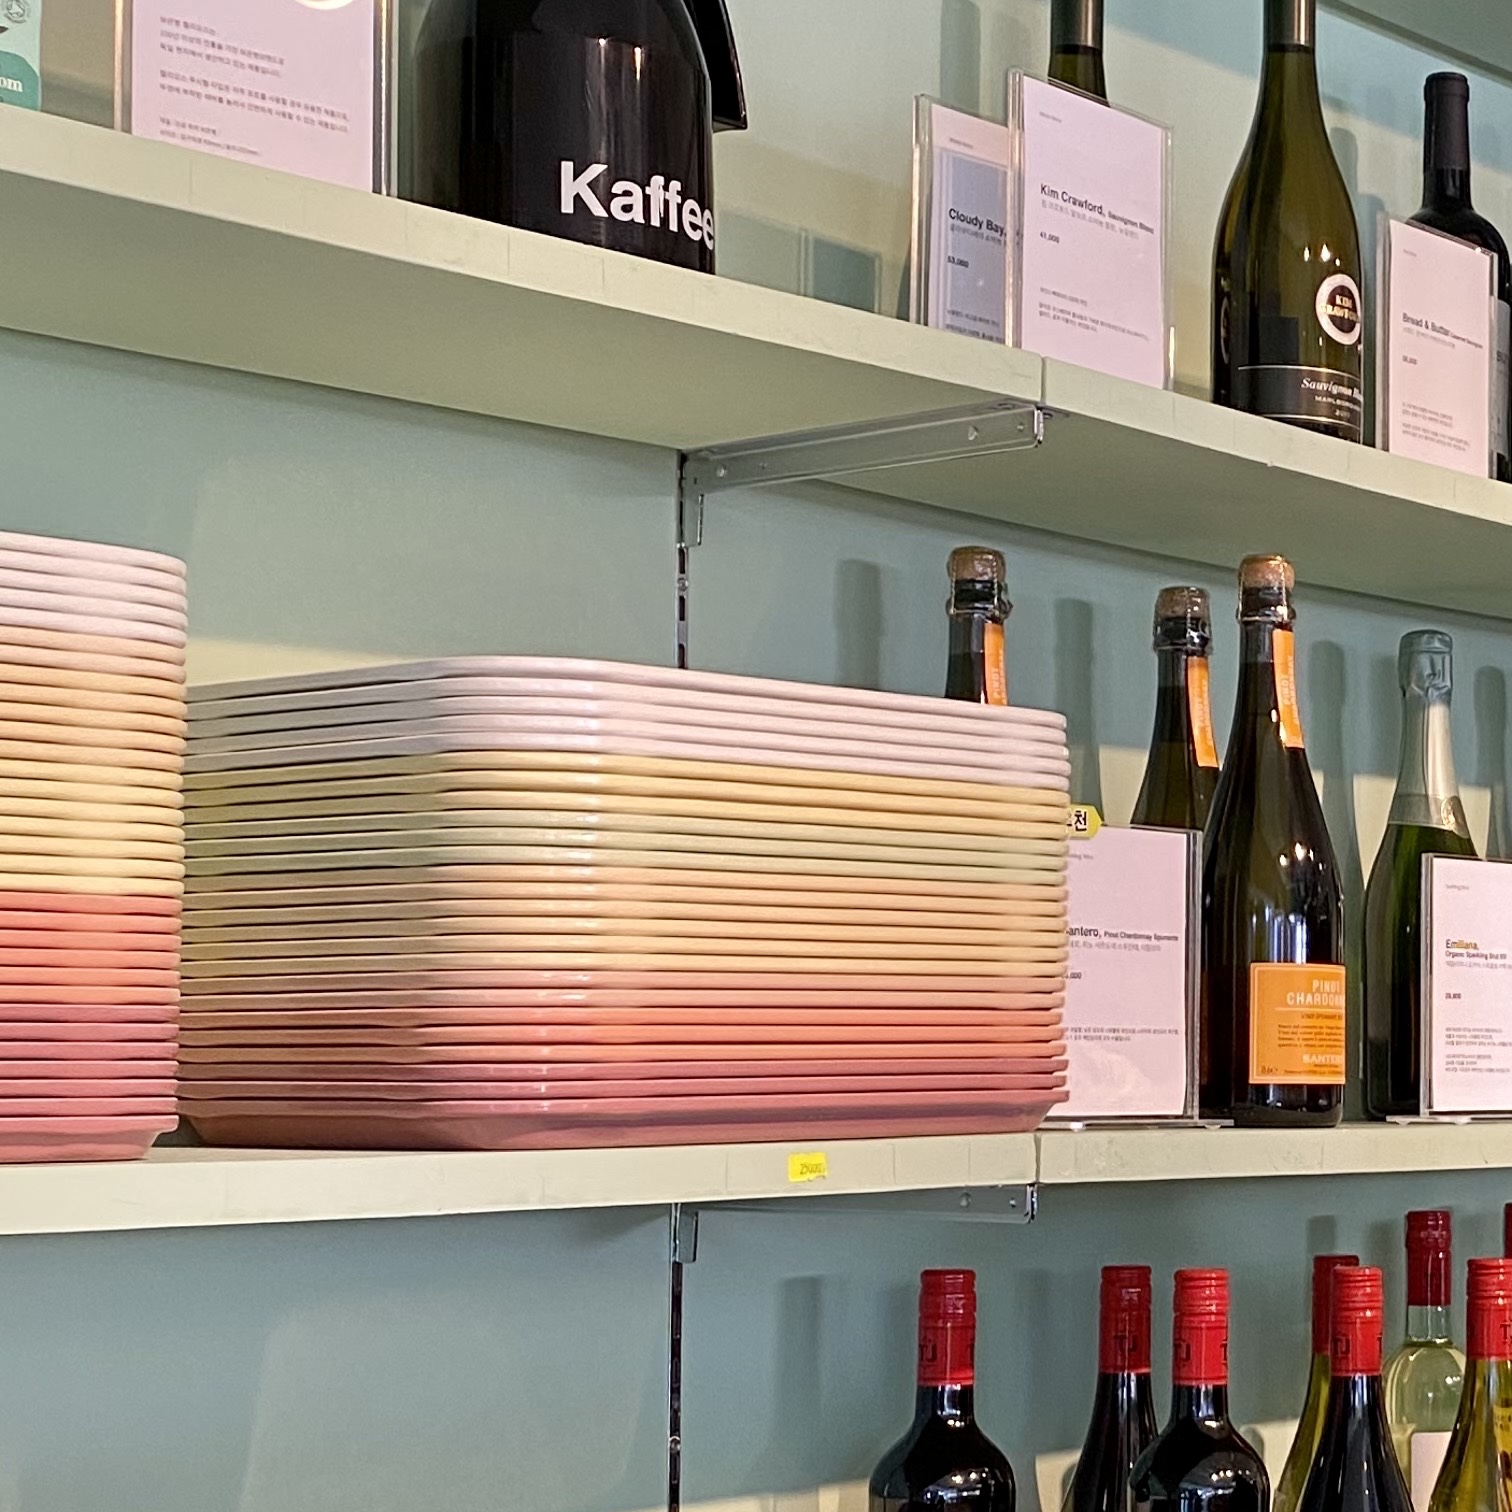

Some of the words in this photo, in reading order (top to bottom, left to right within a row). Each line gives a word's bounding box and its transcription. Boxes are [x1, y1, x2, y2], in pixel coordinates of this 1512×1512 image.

[1040, 183, 1060, 201] Kim
[560, 160, 714, 250] Kaffee
[948, 208, 983, 230] Cloudy
[1402, 313, 1423, 329] Bread
